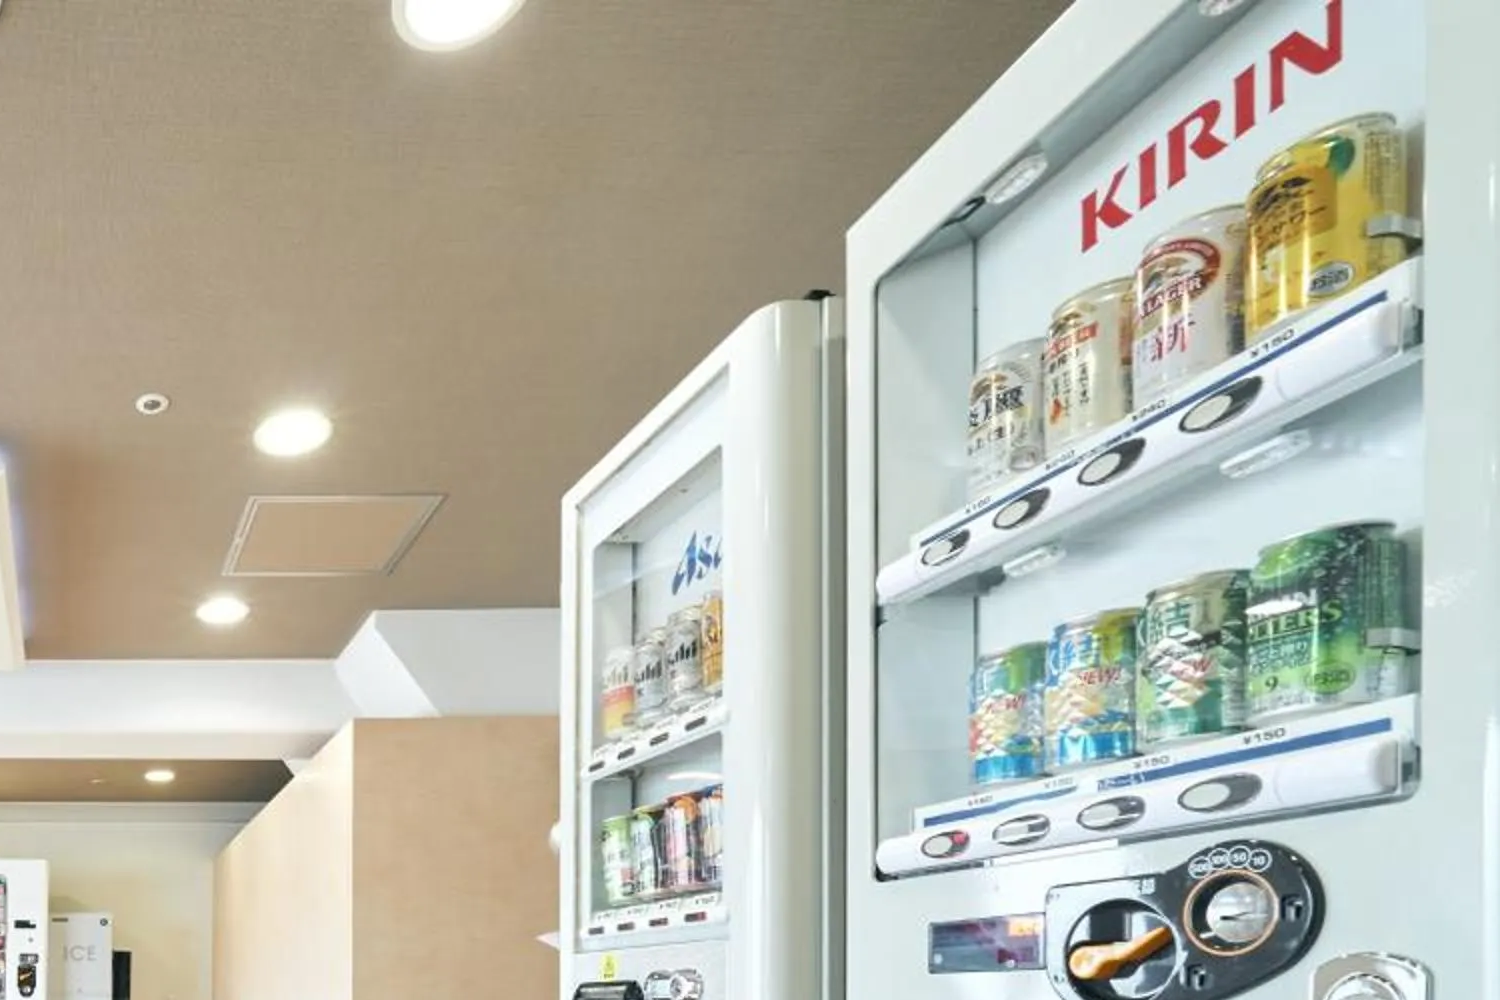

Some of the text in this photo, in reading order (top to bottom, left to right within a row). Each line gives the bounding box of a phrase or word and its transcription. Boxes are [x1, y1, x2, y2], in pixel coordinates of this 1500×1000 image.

[1081, 0, 1343, 253] KIRIN
[1242, 727, 1286, 745] ¥150
[1233, 852, 1247, 863] 50
[1253, 855, 1265, 866] 10
[62, 945, 98, 962] ICE
